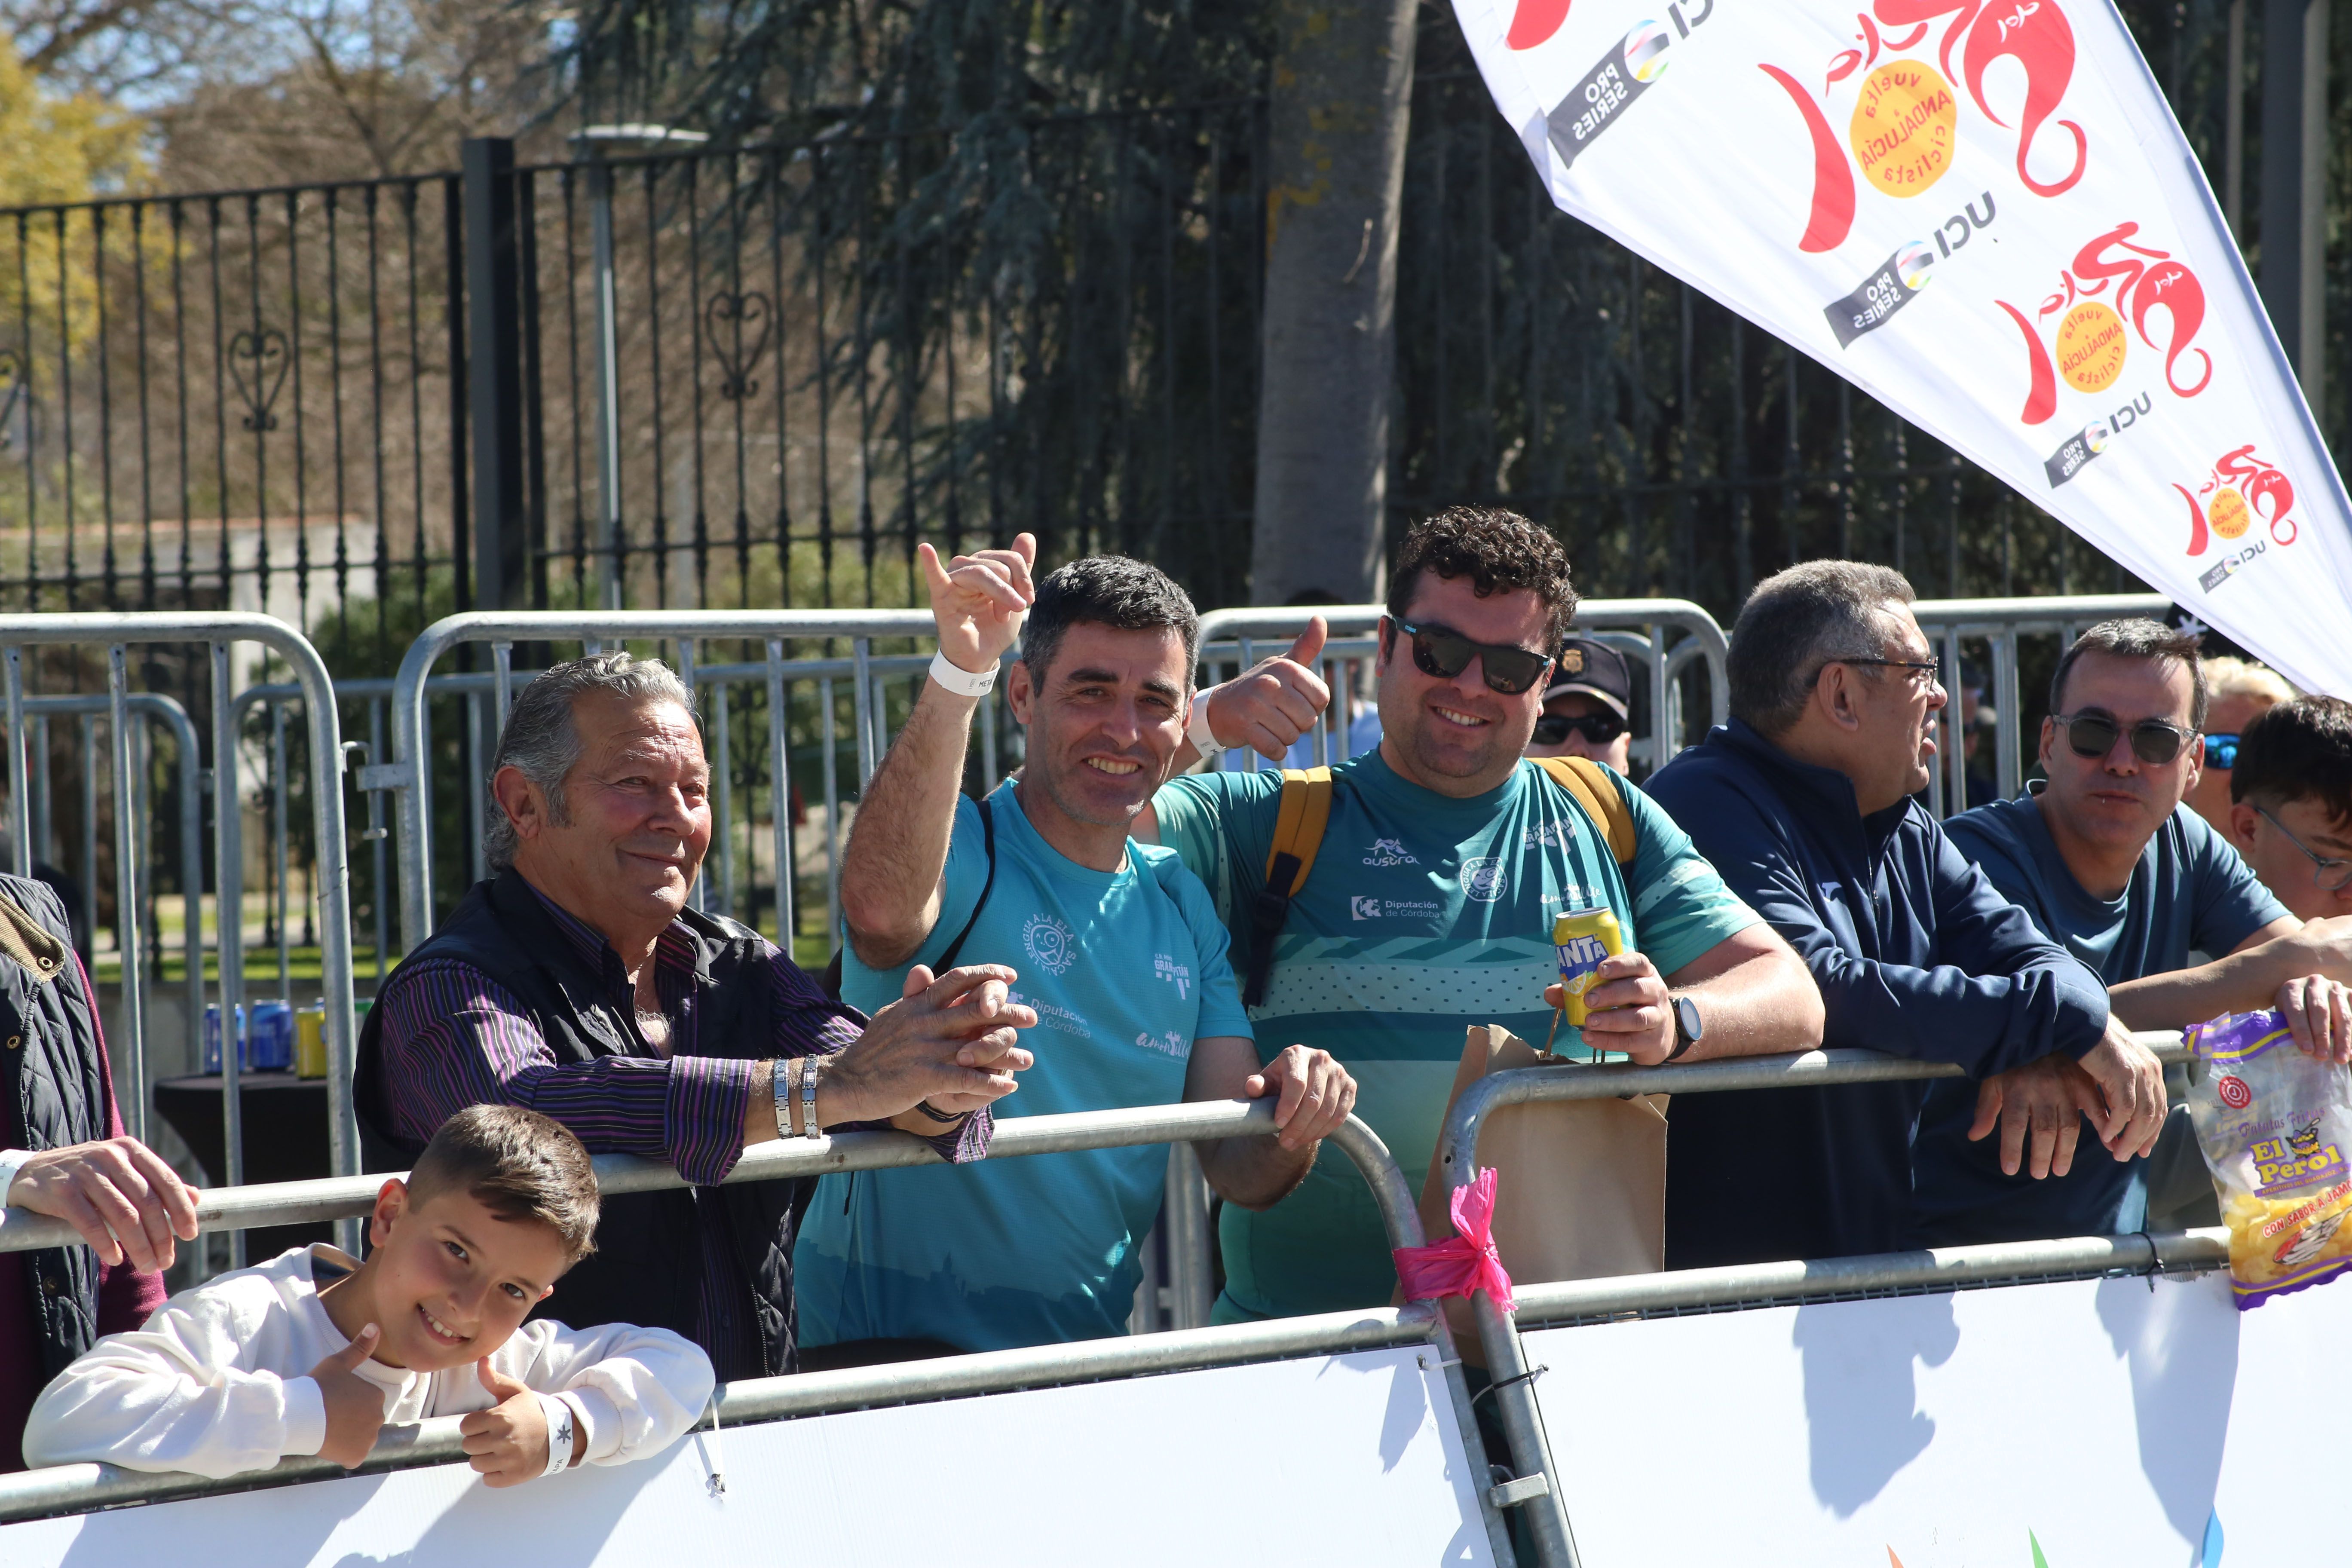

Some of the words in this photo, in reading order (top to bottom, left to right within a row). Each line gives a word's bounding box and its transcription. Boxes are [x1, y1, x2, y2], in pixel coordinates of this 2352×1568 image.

[1385, 900, 1438, 910] Diputación
[1400, 909, 1440, 918] Córdoba
[1556, 936, 1608, 970] ANTA
[1045, 1017, 1090, 1038] Córdoba
[2238, 1118, 2285, 1137] Patatas
[2286, 1107, 2326, 1128] Fritas
[2250, 1139, 2285, 1162] El
[2257, 1145, 2343, 1183] Perol
[2263, 1218, 2285, 1237] CON
[2287, 1203, 2316, 1226] SABOR
[2318, 1197, 2325, 1208] A
